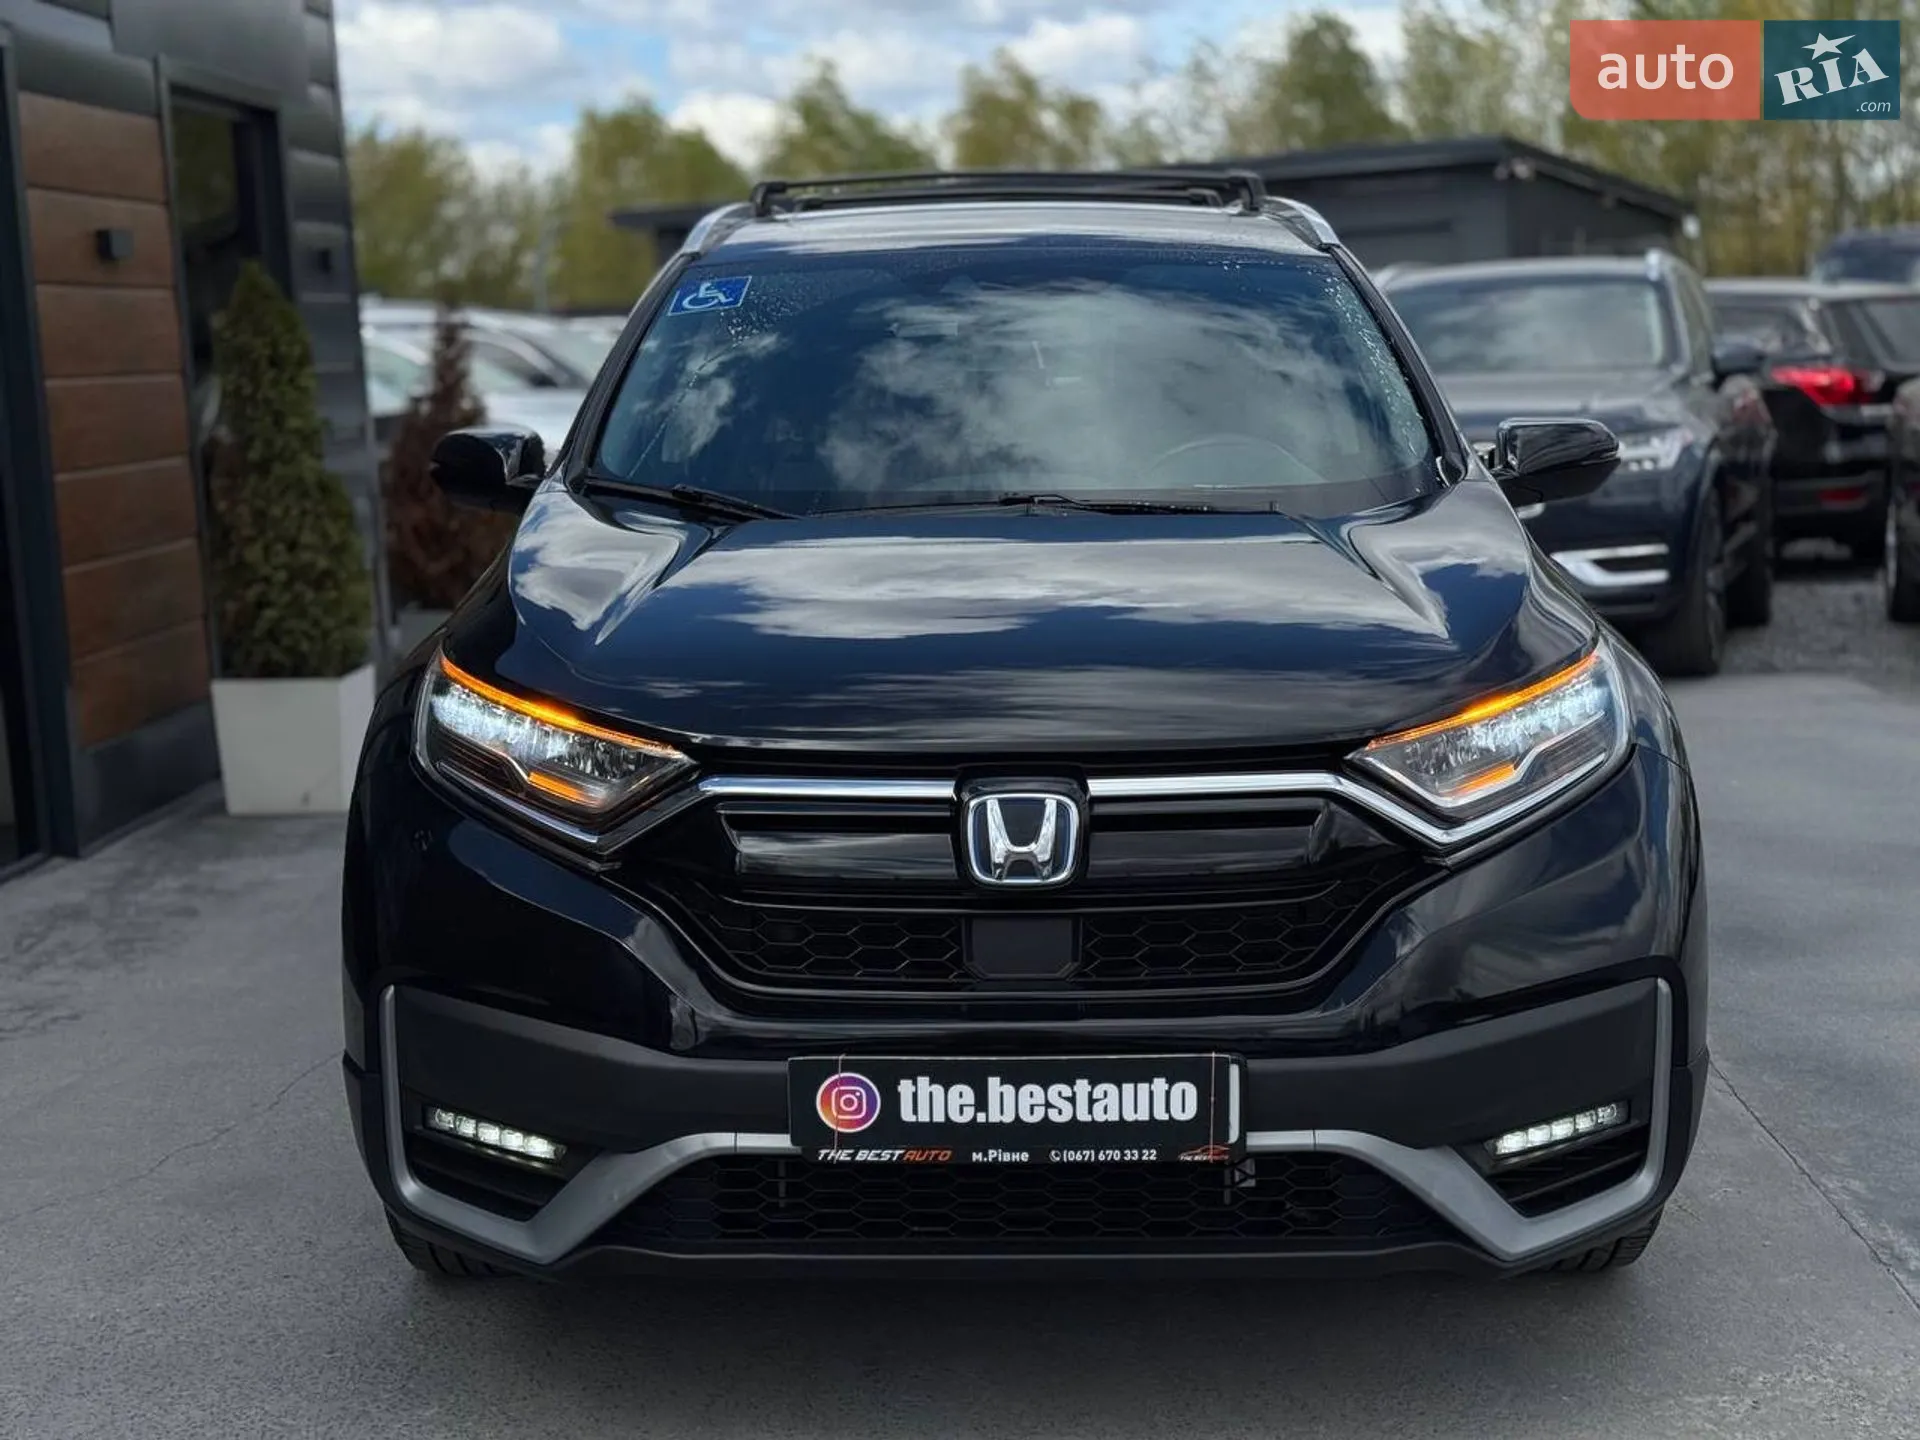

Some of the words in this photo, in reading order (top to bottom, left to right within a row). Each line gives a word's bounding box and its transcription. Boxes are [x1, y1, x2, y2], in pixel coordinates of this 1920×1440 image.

[898, 1076, 1198, 1123] the.bestauto
[818, 1148, 855, 1161] THE
[1063, 1149, 1096, 1163] (067)
[1098, 1150, 1121, 1162] 670
[1123, 1150, 1140, 1162] 33
[1141, 1149, 1157, 1161] 22
